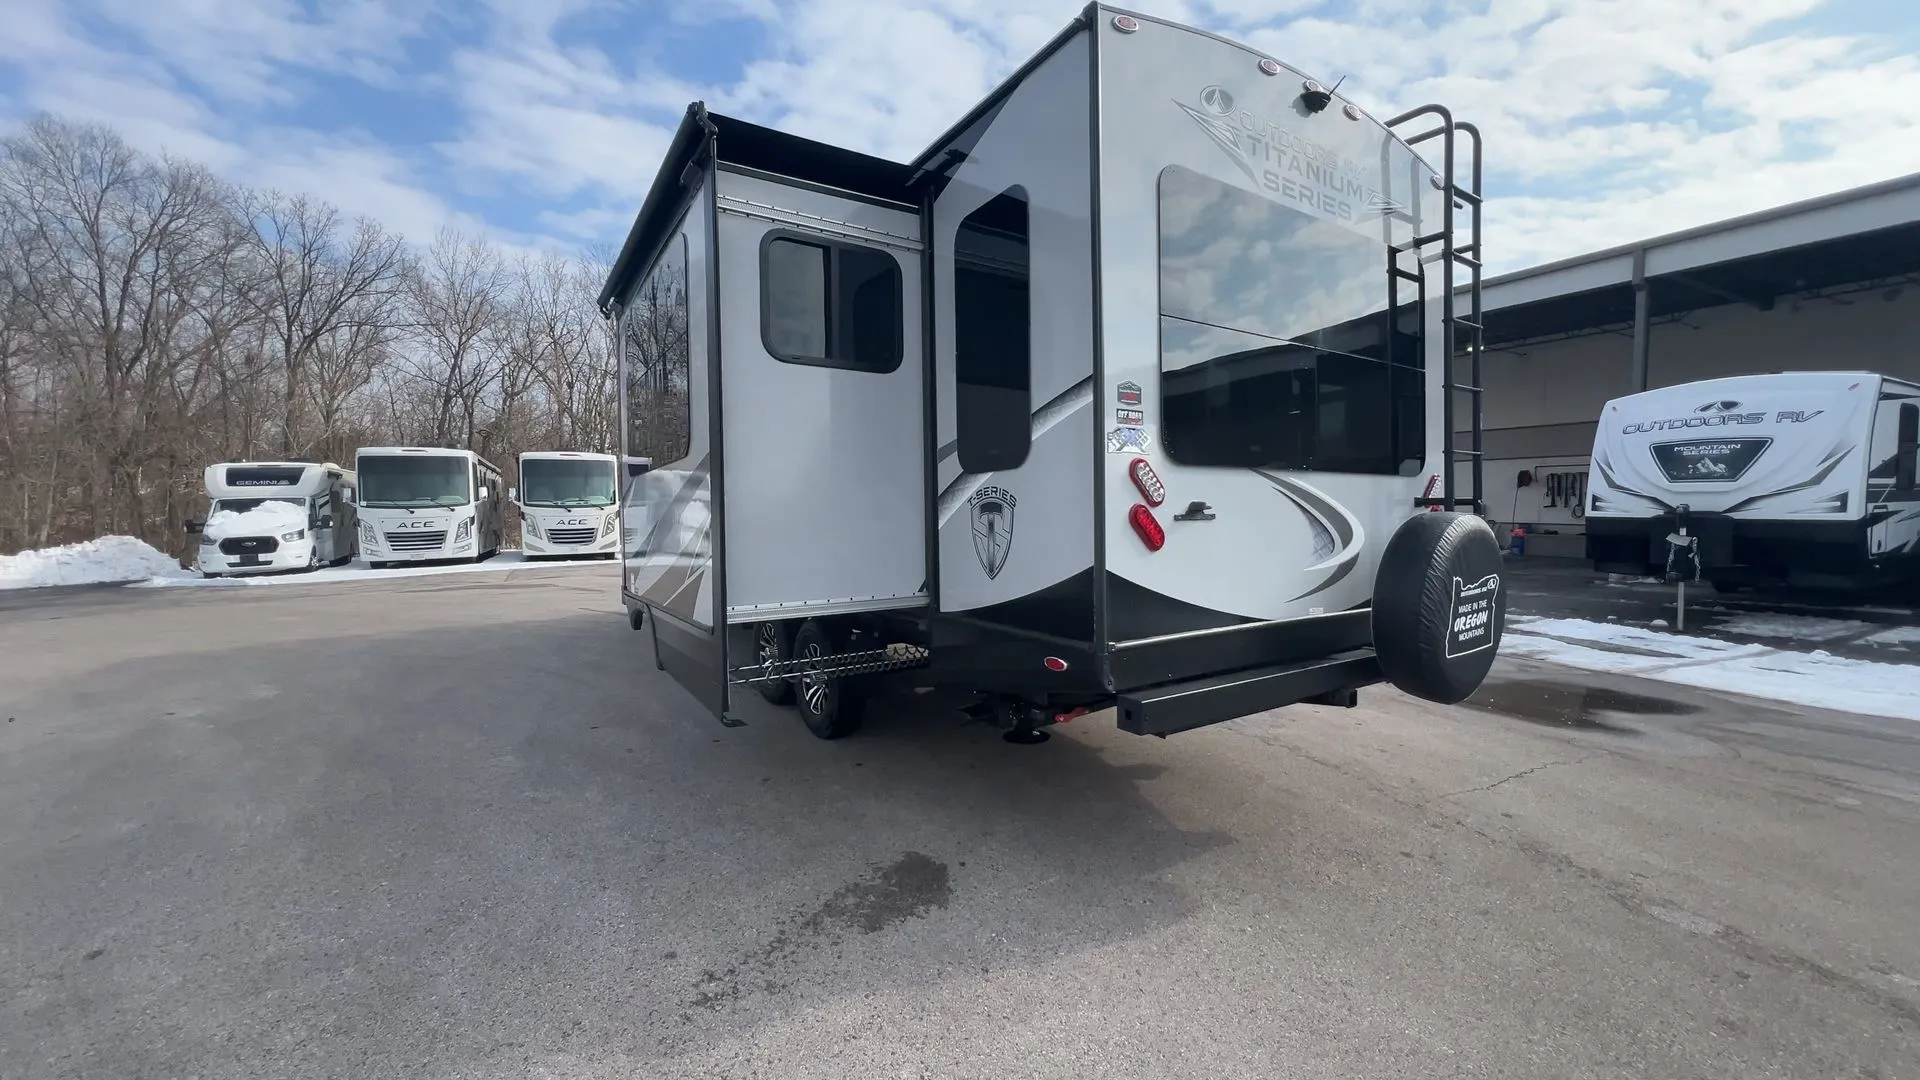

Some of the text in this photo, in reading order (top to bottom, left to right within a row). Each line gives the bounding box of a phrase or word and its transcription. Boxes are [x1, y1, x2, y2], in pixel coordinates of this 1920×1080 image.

[1239, 110, 1337, 170] OUTDOORS
[1246, 134, 1363, 202] TITANIUM
[1263, 169, 1352, 221] SERIES
[1117, 409, 1129, 419] OFF
[1622, 410, 1825, 435] OUTDOORS RV
[1673, 443, 1742, 452] MOUNTAIN
[1682, 448, 1731, 456] SERIES
[966, 485, 1018, 508] T-SERIES
[396, 520, 434, 529] ACE
[1458, 599, 1488, 614] MADE IN THE
[1454, 610, 1489, 633] OREGON
[1458, 626, 1485, 642] MOUNTAINS
